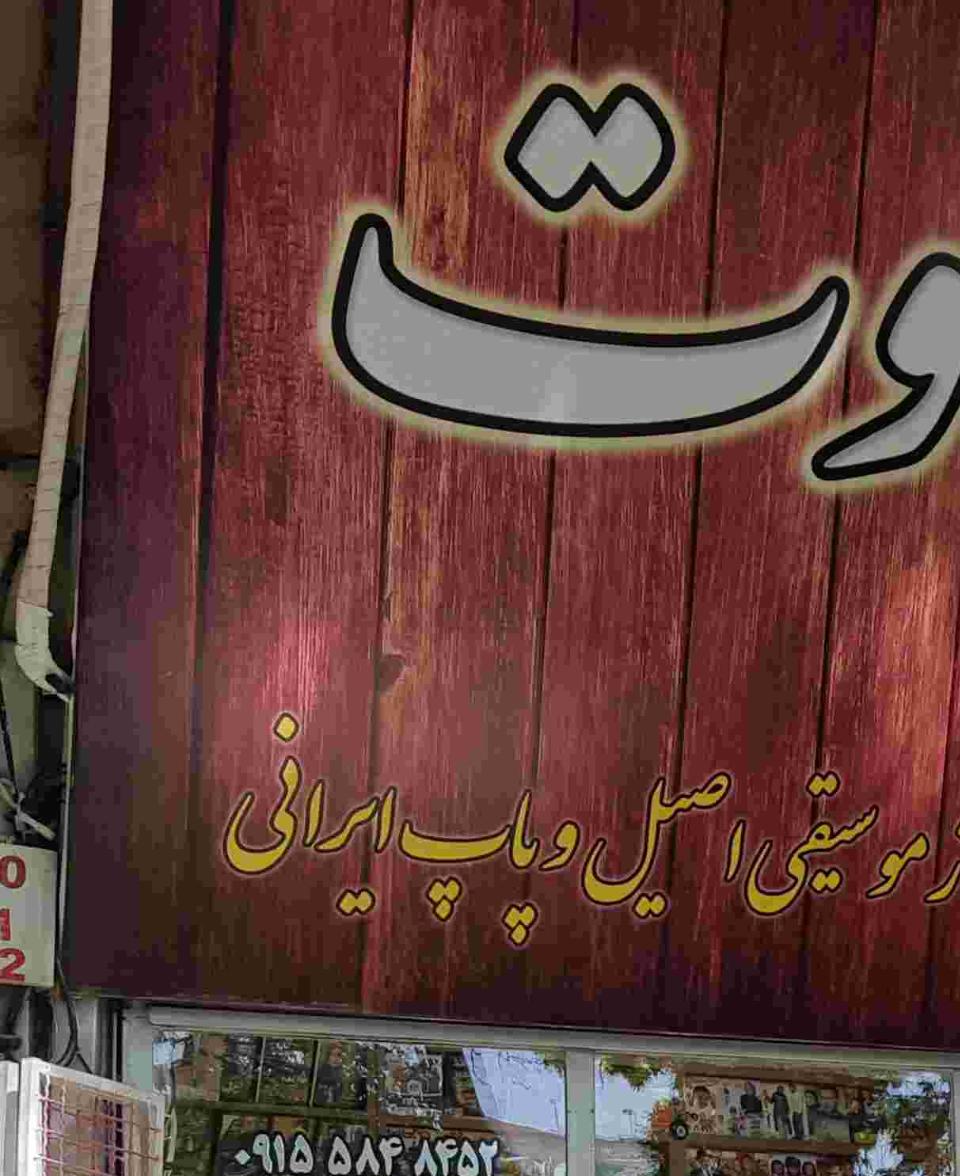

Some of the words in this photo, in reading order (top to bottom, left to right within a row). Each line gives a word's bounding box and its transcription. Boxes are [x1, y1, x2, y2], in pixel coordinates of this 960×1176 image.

[222, 711, 399, 917] ایرانی
[398, 789, 541, 947] پاپ
[539, 819, 581, 872] و
[580, 770, 748, 920] اصیل
[744, 770, 930, 917] موسیقی
[234, 1131, 314, 1175] ۰۹۱۵
